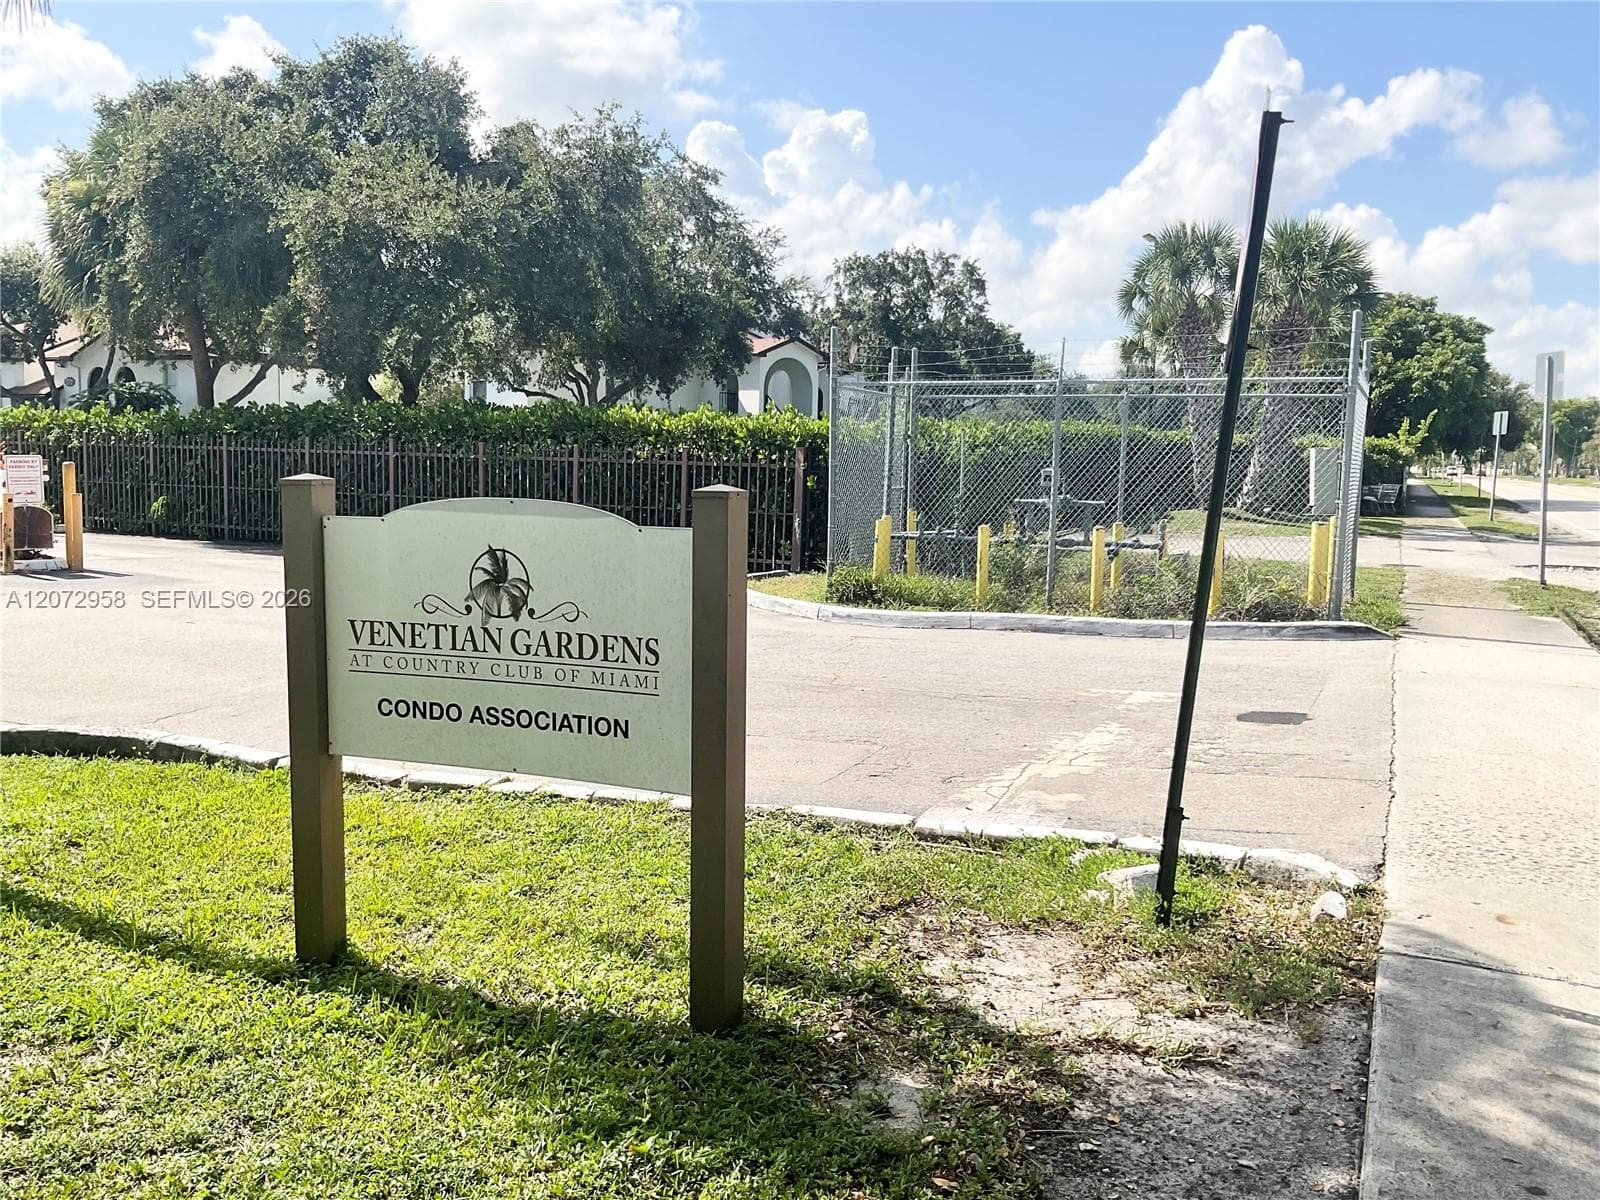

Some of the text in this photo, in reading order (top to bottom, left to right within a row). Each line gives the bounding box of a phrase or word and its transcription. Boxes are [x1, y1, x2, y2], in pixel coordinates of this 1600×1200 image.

[347, 618, 660, 667] VENETIAN GARDENS
[350, 653, 659, 690] AT COUNTRY CLUB OF MIAMI
[377, 698, 630, 740] CONDO ASSOCIATION
